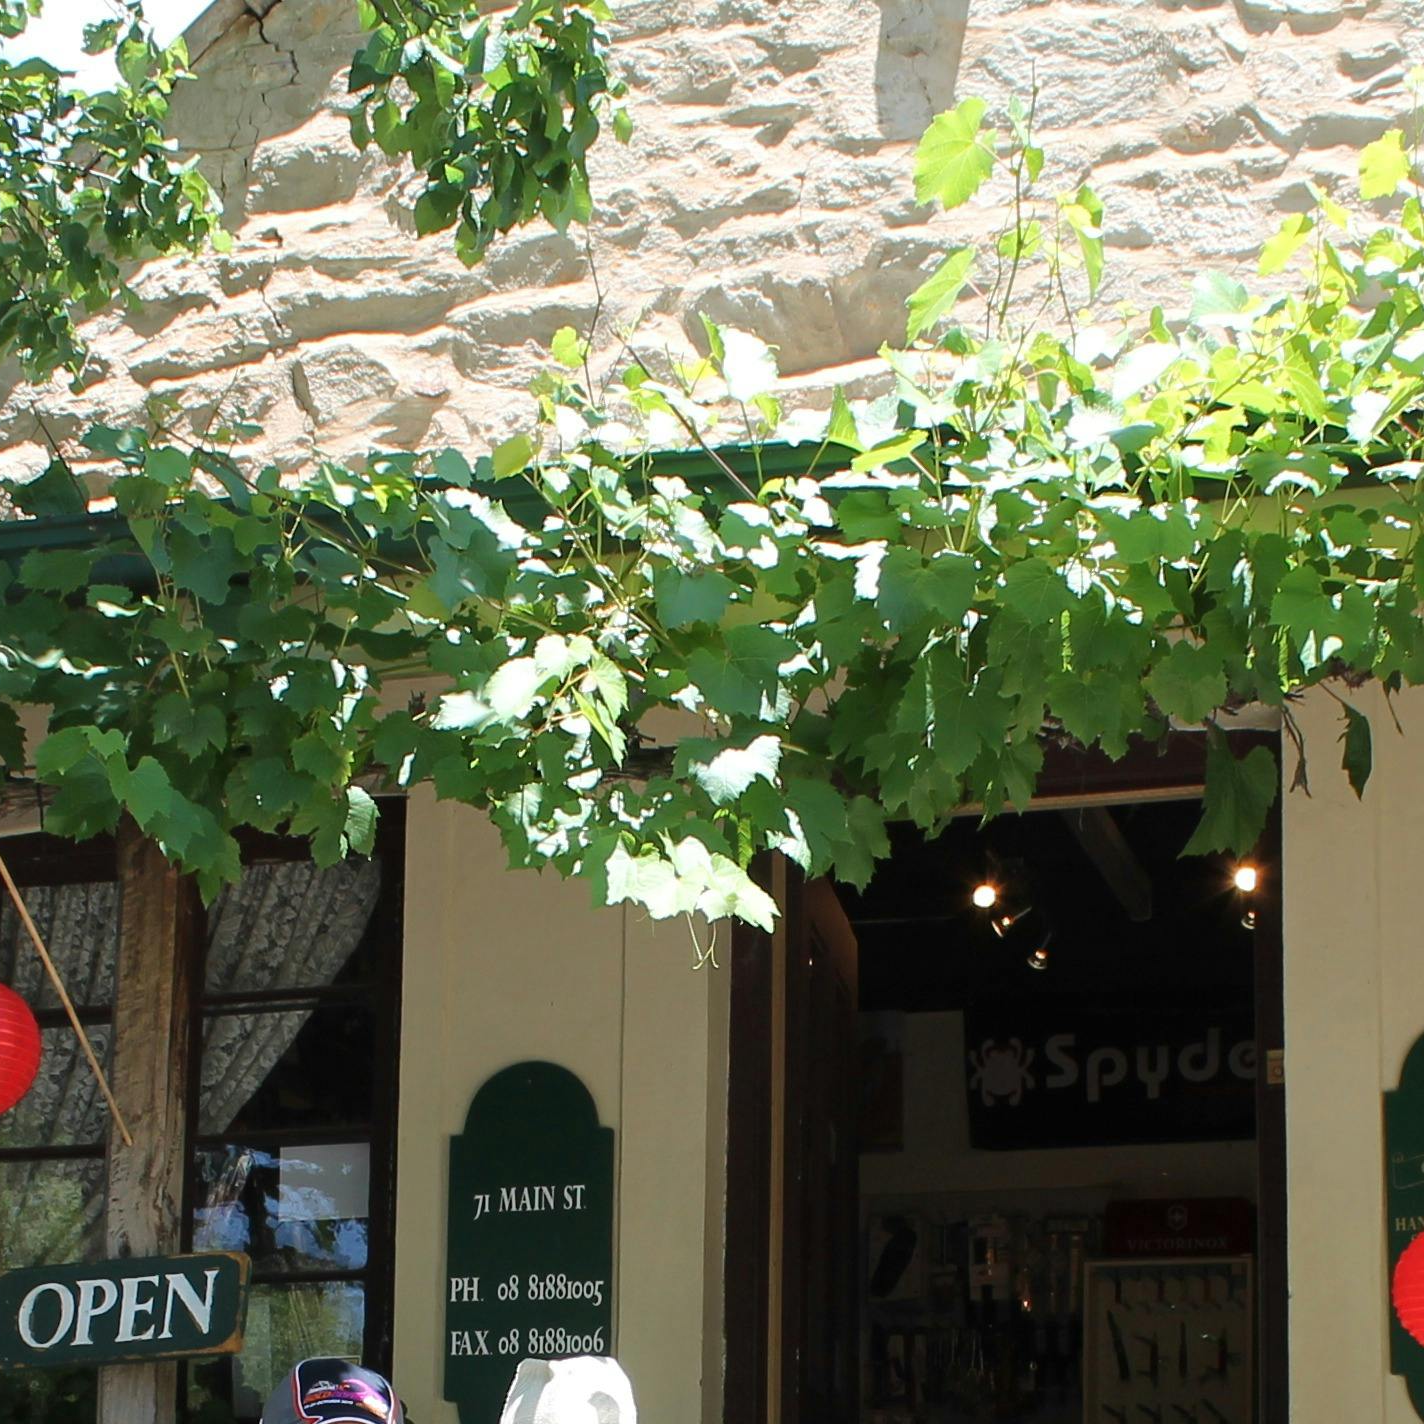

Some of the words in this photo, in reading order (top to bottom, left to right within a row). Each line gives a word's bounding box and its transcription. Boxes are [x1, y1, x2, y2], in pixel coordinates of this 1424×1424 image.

[1044, 1027, 1257, 1103] Spyde
[473, 1194, 490, 1220] 71
[499, 1186, 555, 1212] MAIN
[1127, 1237, 1228, 1250] VICTORINOX
[450, 1277, 484, 1302] PH.
[497, 1274, 519, 1301] 08
[527, 1273, 604, 1307] 81881005
[18, 1269, 220, 1348] OPEN
[450, 1329, 493, 1356] FAX.
[498, 1328, 520, 1354] 08
[527, 1326, 604, 1354] 81881006
